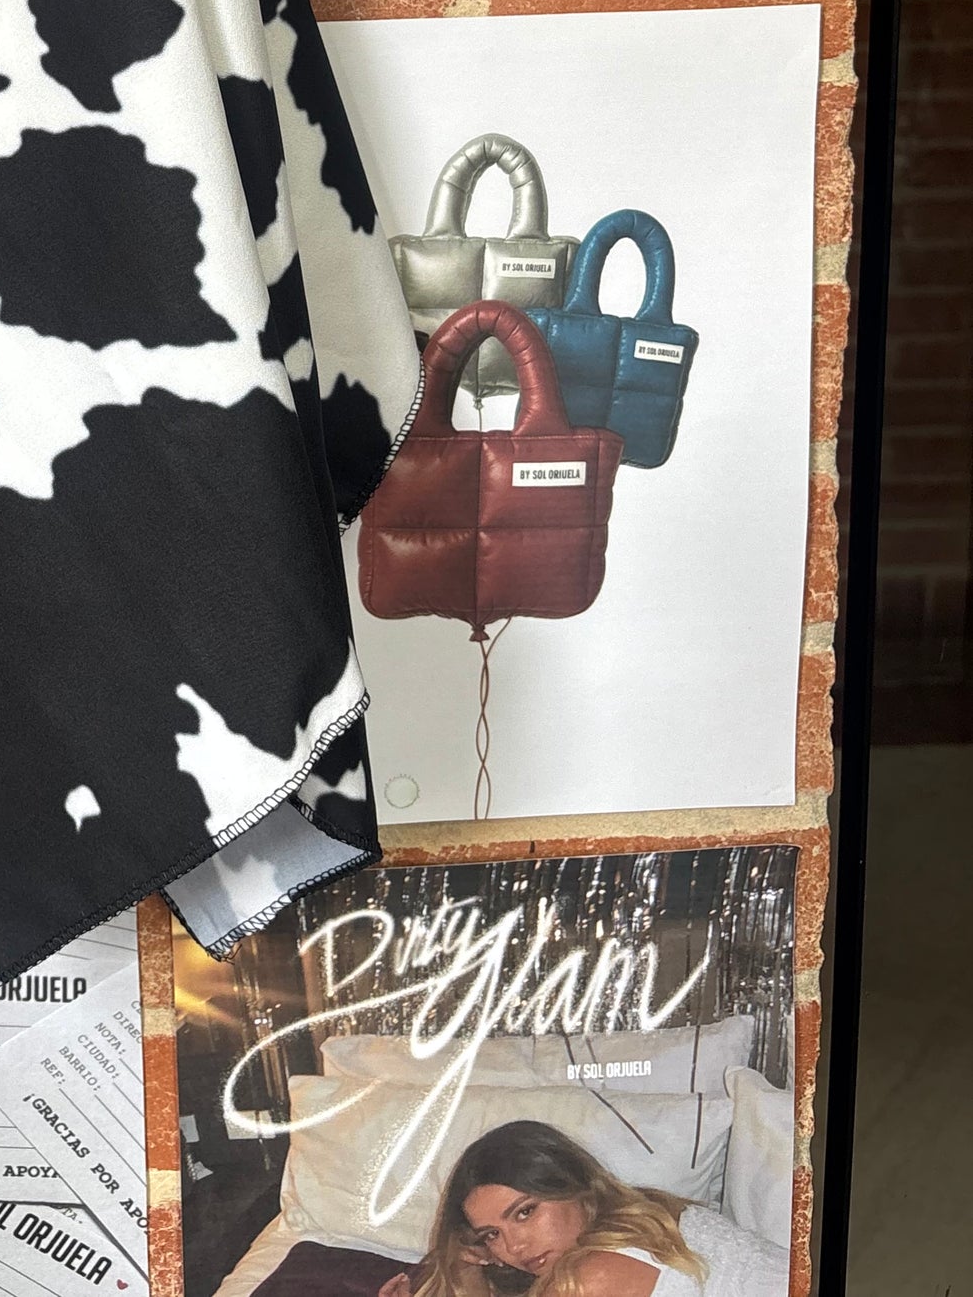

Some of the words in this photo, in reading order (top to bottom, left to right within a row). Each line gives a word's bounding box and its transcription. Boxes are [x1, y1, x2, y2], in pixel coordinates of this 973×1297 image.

[520, 470, 530, 479] BY
[532, 470, 547, 480] SOL
[77, 1034, 120, 1079] CIUDAD:
[94, 1022, 127, 1055] NOTA:
[40, 1057, 66, 1085] REF:
[58, 1045, 101, 1092] BARRIO:
[567, 1065, 581, 1080] BY
[583, 1063, 604, 1079] SOL
[606, 1061, 652, 1078] ORJUELA
[23, 1093, 91, 1160] ¡GRACIAS
[90, 1163, 120, 1194] POR
[13, 1213, 113, 1286] ORJUELA
